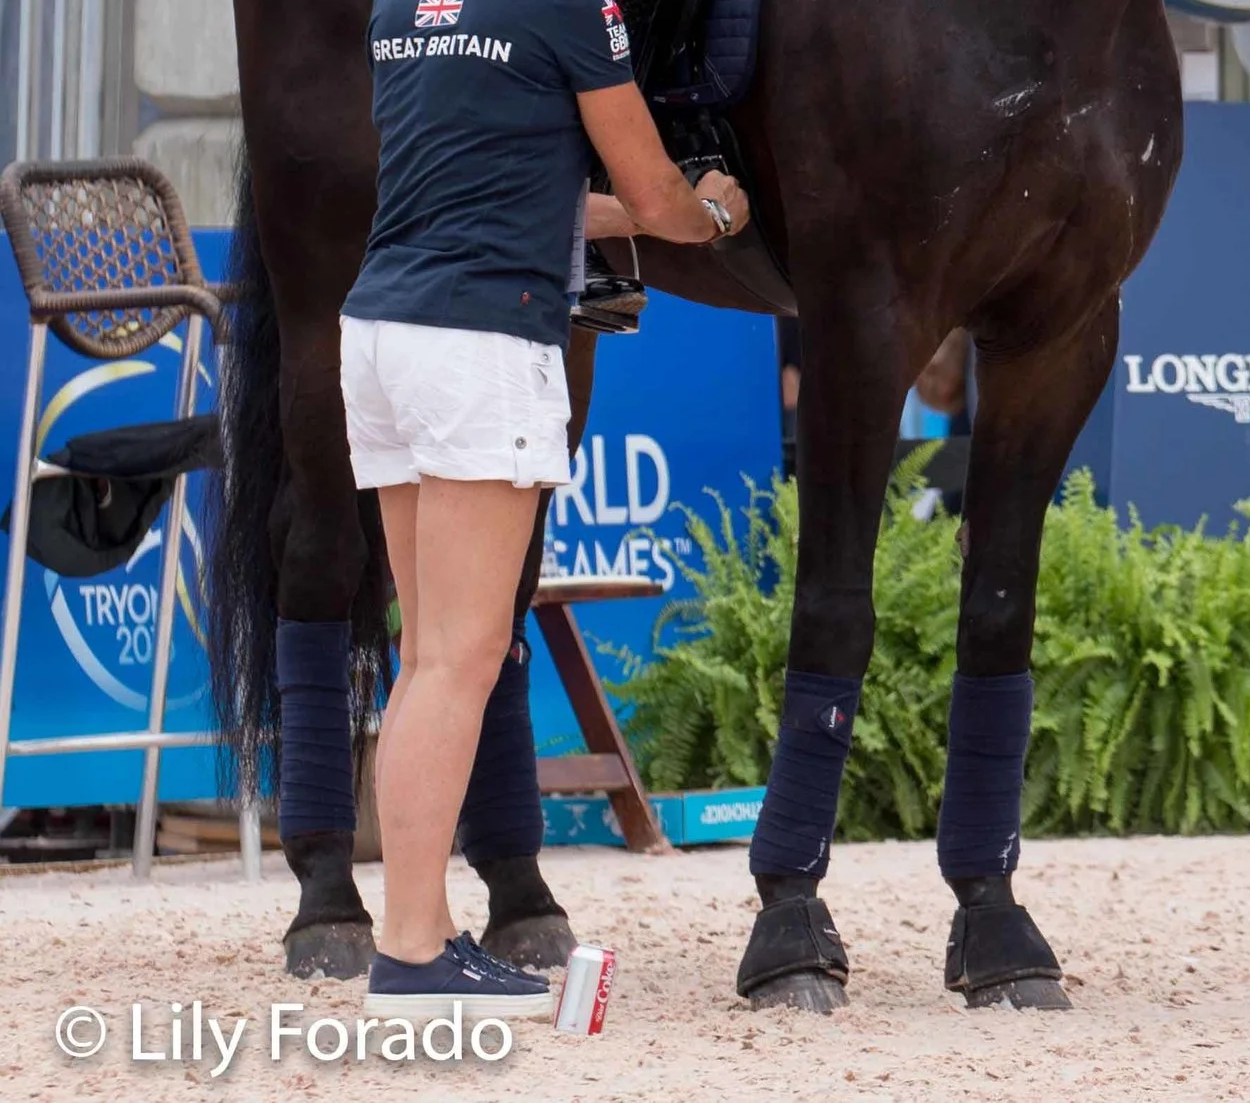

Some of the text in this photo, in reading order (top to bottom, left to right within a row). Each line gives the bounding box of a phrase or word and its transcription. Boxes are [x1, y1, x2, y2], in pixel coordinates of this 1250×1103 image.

[373, 34, 512, 63] GREAT BRITAIN
[597, 960, 616, 1004] Coke
